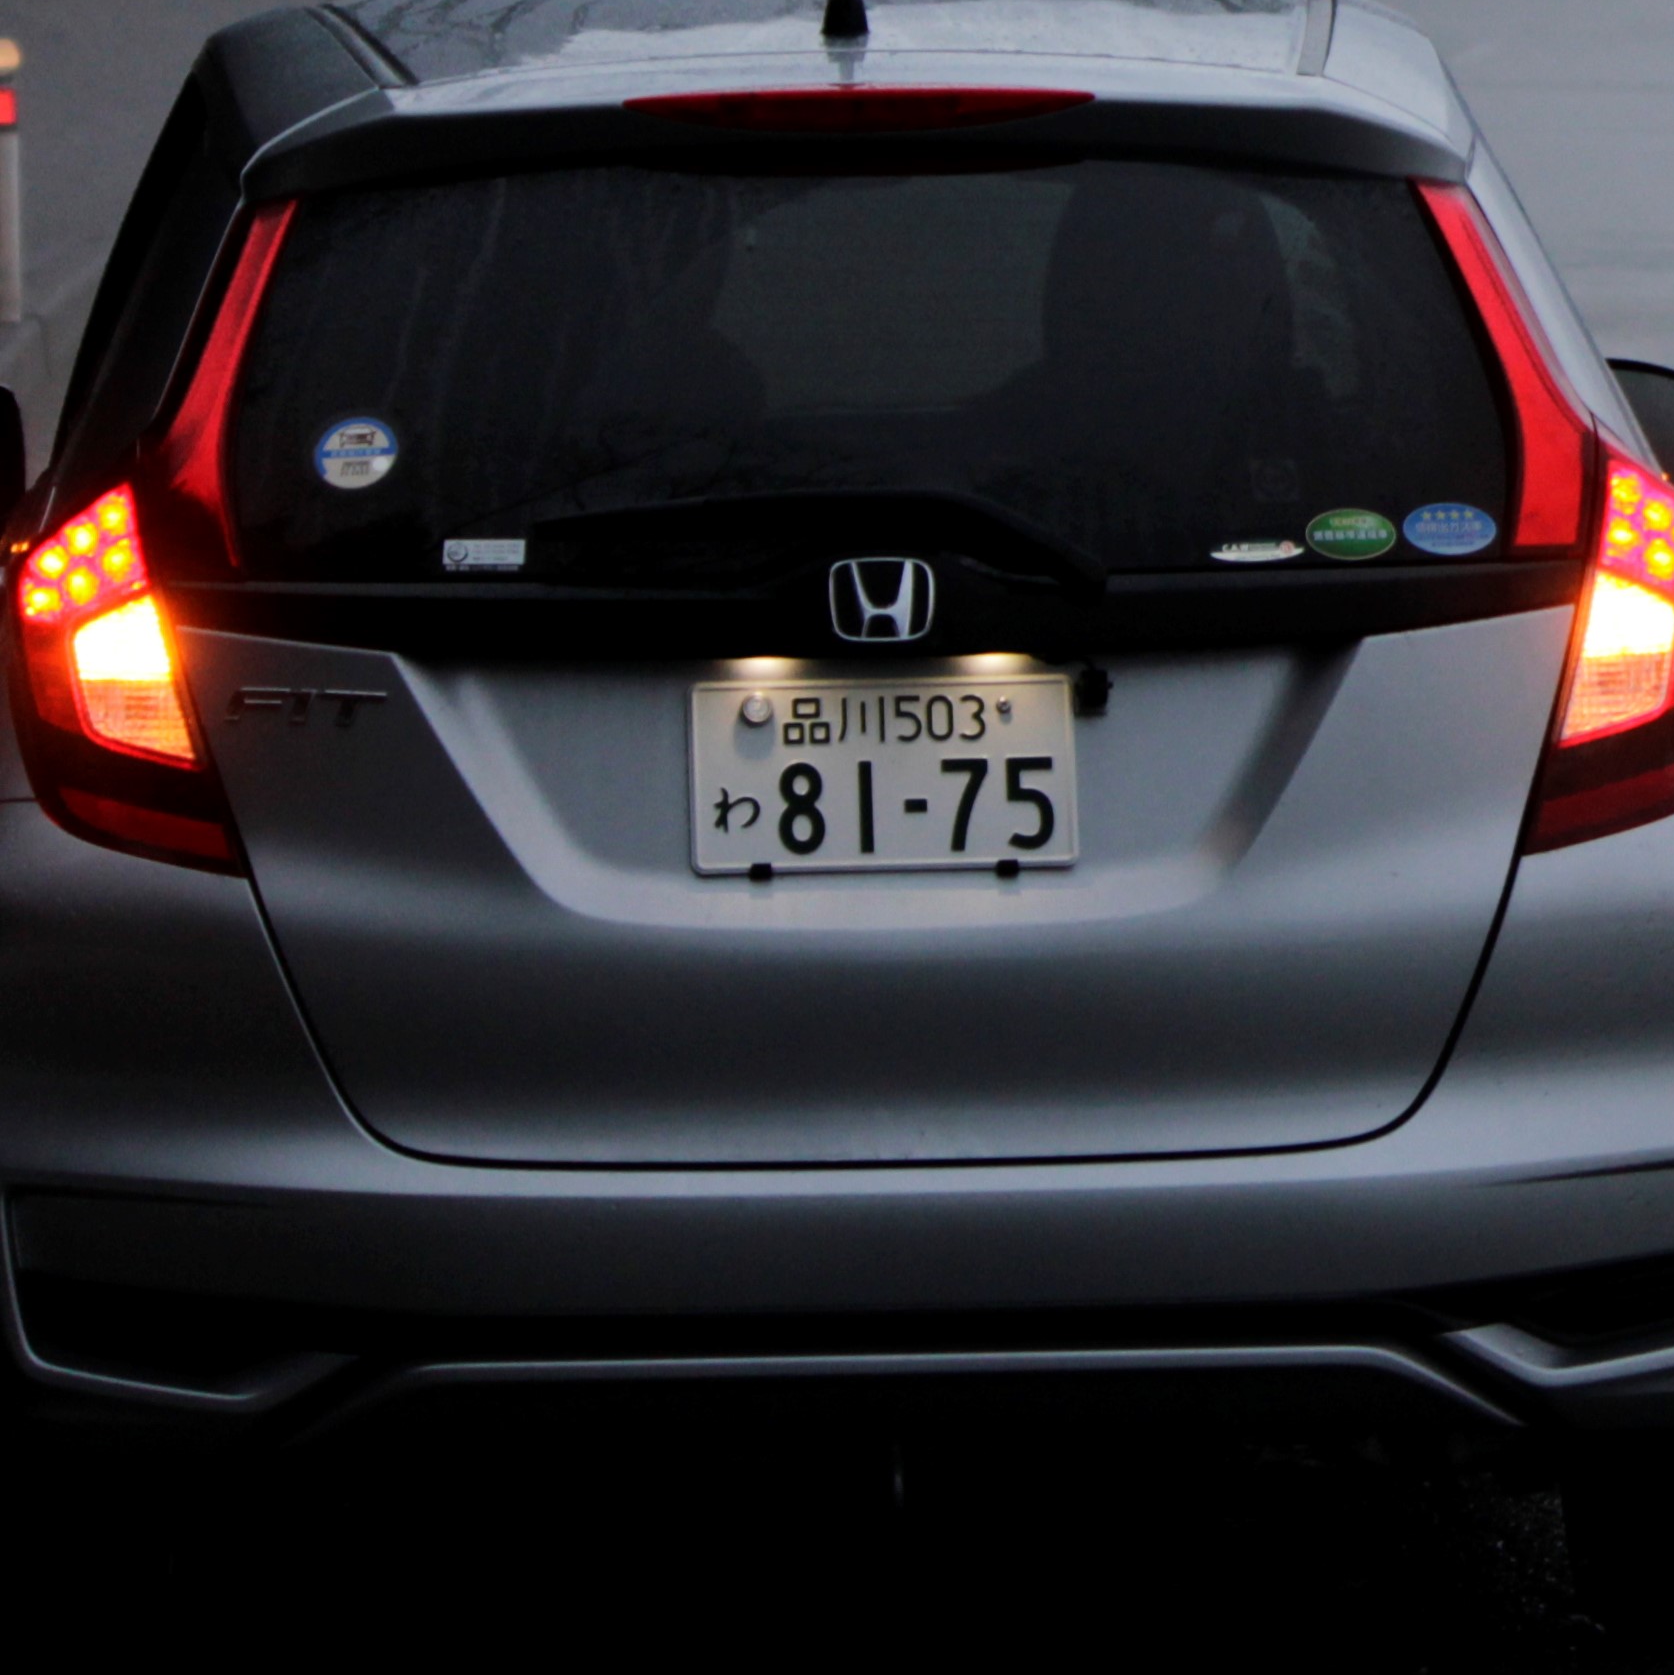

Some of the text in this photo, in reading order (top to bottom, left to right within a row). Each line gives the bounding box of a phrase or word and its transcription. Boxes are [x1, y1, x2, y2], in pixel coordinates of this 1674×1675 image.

[224, 686, 388, 727] FIT
[714, 756, 1055, 855] わ 81-75
